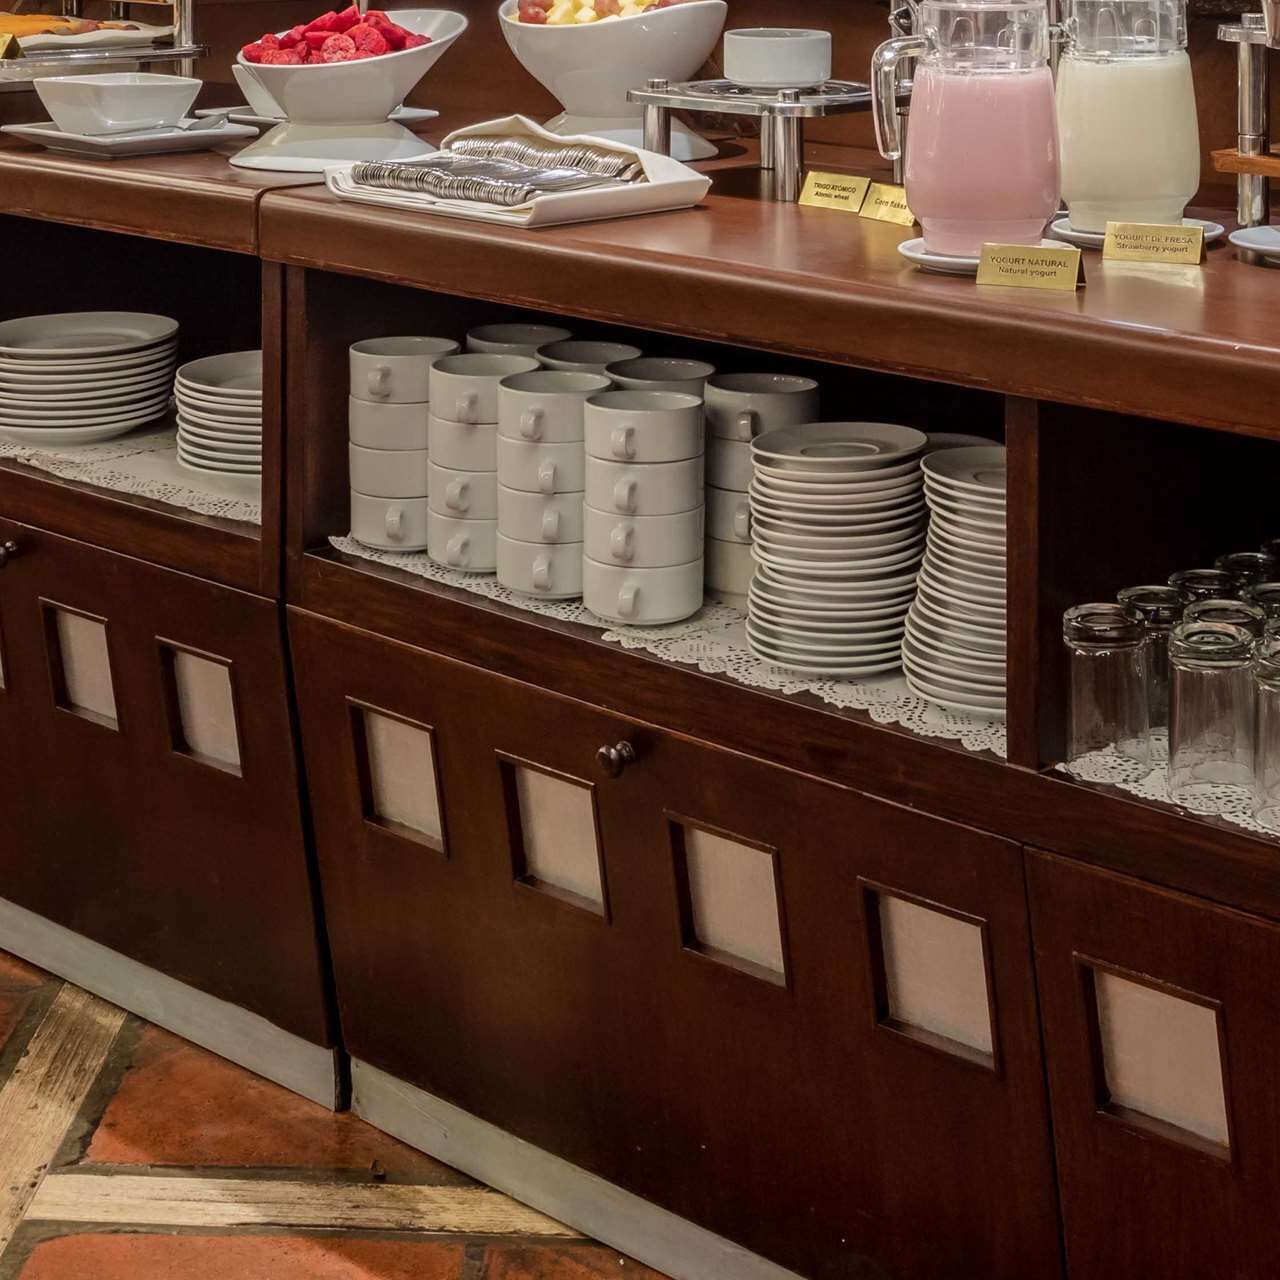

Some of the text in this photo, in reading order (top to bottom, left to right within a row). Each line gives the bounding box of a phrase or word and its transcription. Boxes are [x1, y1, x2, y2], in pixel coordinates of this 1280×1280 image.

[1116, 242, 1189, 253] Strawberry yogurt
[990, 256, 1069, 268] YOGURT NATURAL
[998, 266, 1057, 277] Natural yogurt
